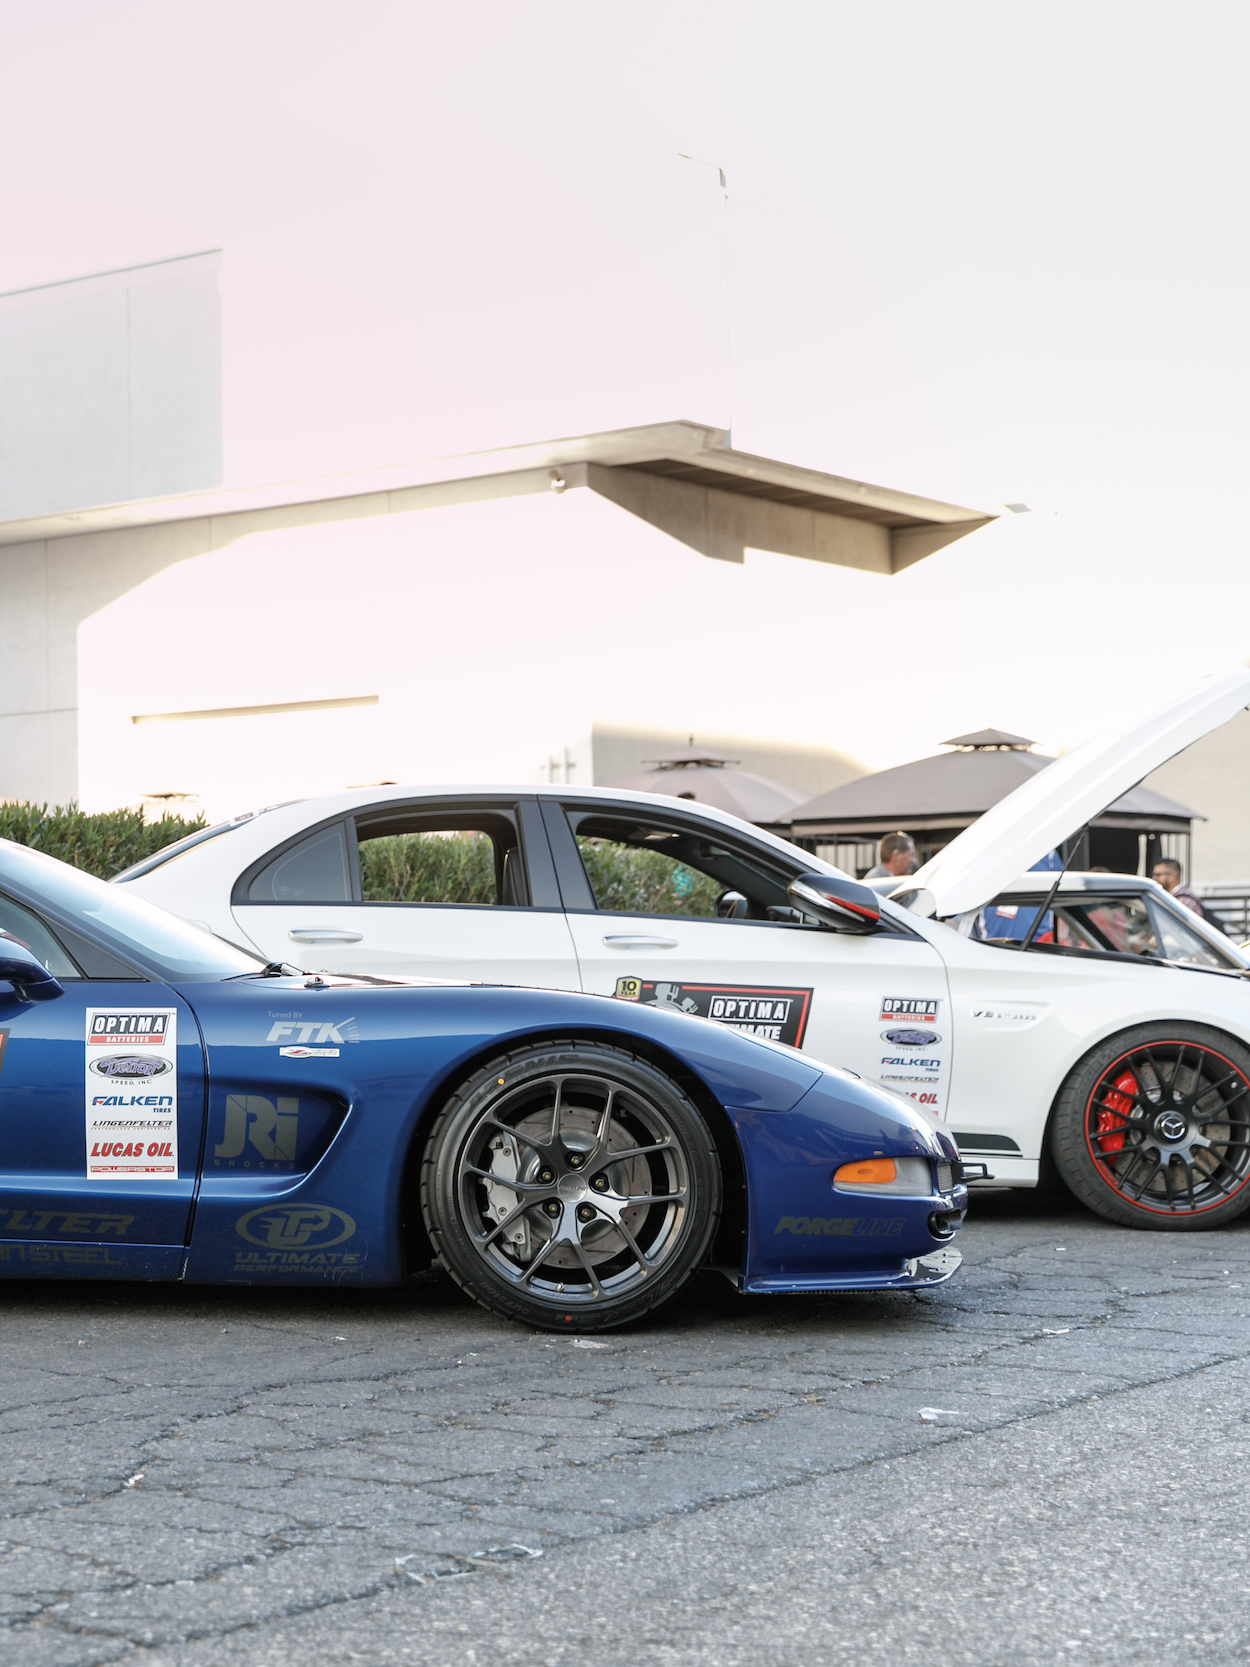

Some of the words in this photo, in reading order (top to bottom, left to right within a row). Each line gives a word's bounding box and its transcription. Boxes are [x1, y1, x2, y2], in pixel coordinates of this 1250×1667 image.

[621, 980, 637, 992] 10
[712, 999, 785, 1020] OPTIMA
[882, 999, 937, 1015] OPTIMA
[93, 1016, 165, 1034] OPTIMA
[265, 1017, 355, 1044] FTK
[105, 1035, 150, 1044] BATTERIES
[100, 1057, 164, 1077] Detroit
[880, 1057, 941, 1067] FALKEN
[91, 1096, 173, 1106] FALKEN
[918, 1092, 938, 1105] OIL
[90, 1142, 145, 1157] LUCAS
[214, 1159, 295, 1169] SHOCKS
[774, 1216, 907, 1237] FORGELINE
[234, 1252, 361, 1264] ULTIMATE
[232, 1264, 359, 1273] PERFORMANCE
